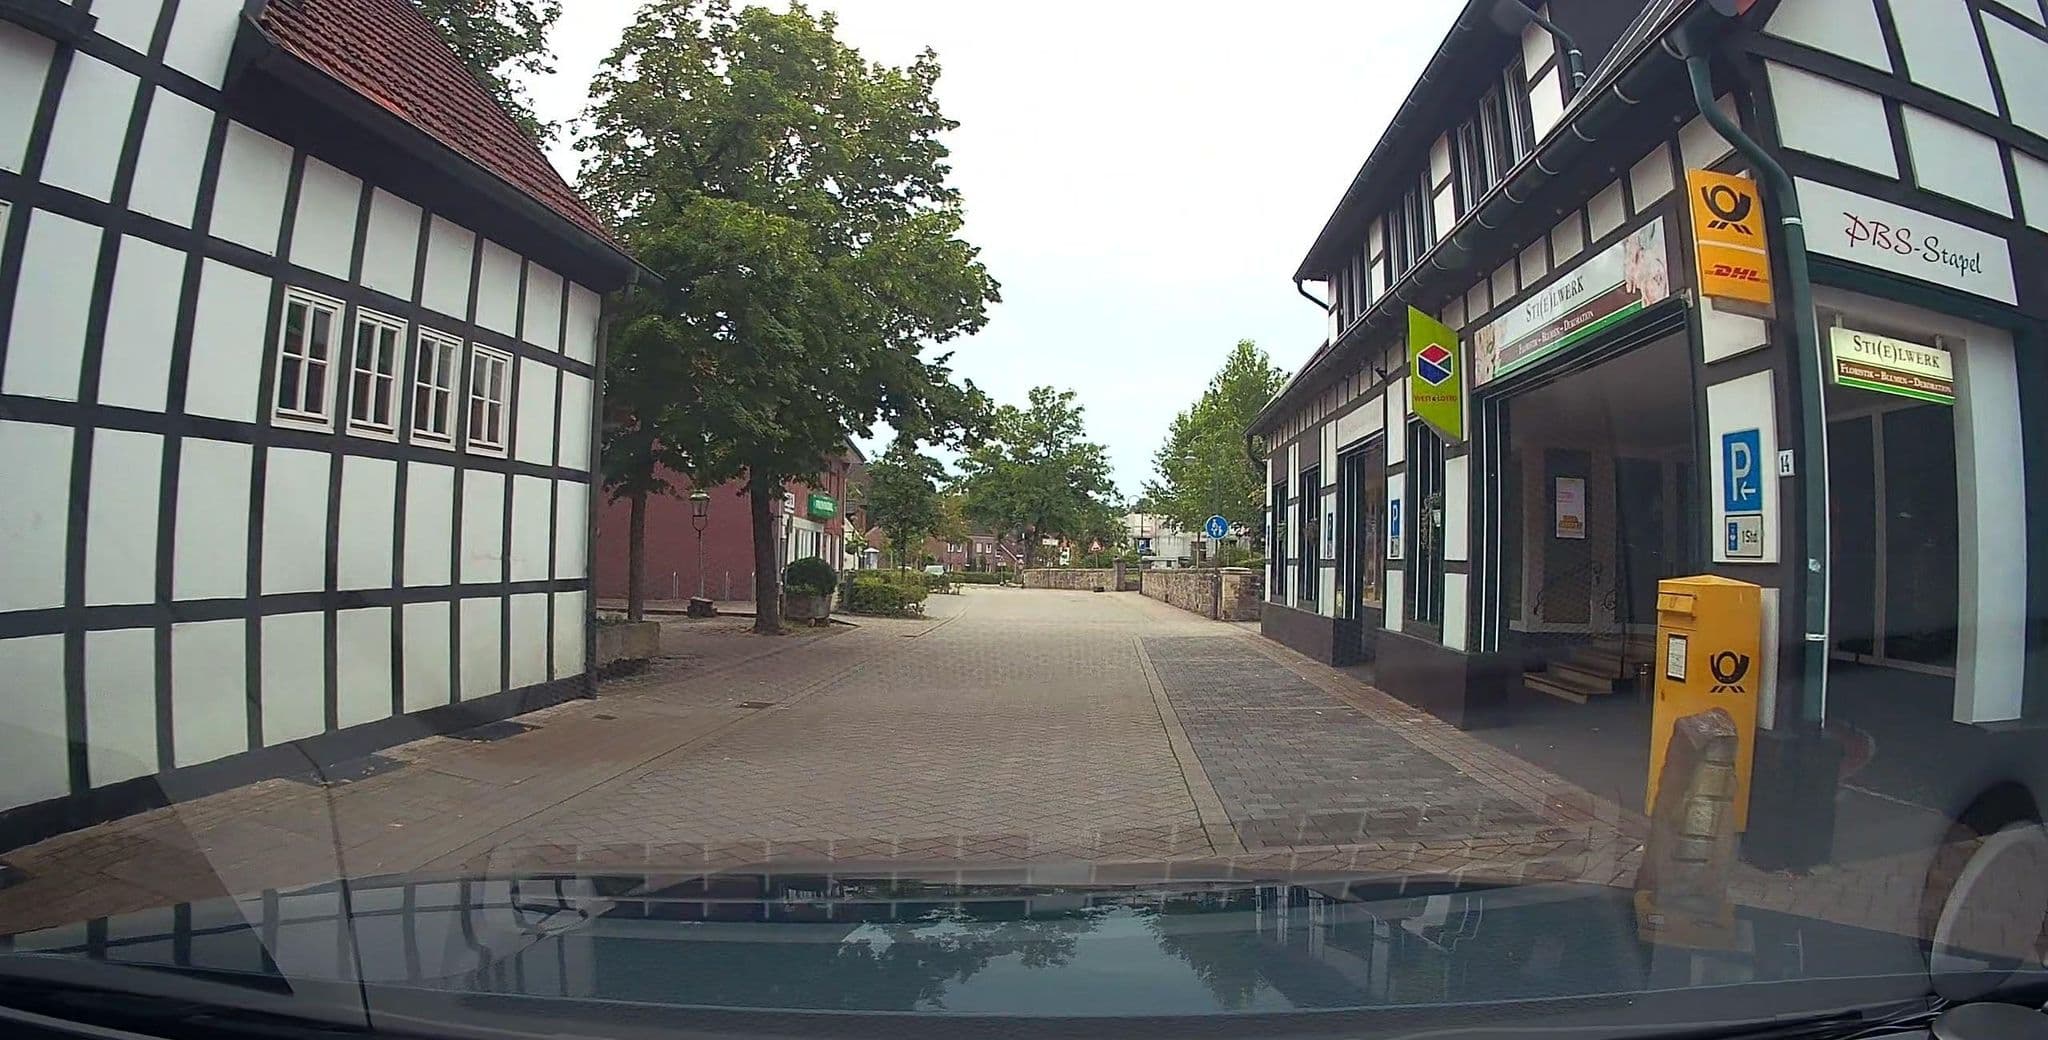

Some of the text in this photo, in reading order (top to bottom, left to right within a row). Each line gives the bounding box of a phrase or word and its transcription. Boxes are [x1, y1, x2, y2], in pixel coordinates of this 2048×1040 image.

[1843, 211, 1982, 277] PBS-Stapel
[1713, 264, 1761, 281] DHL
[1731, 441, 1752, 501] P
[1780, 454, 1790, 473] 14
